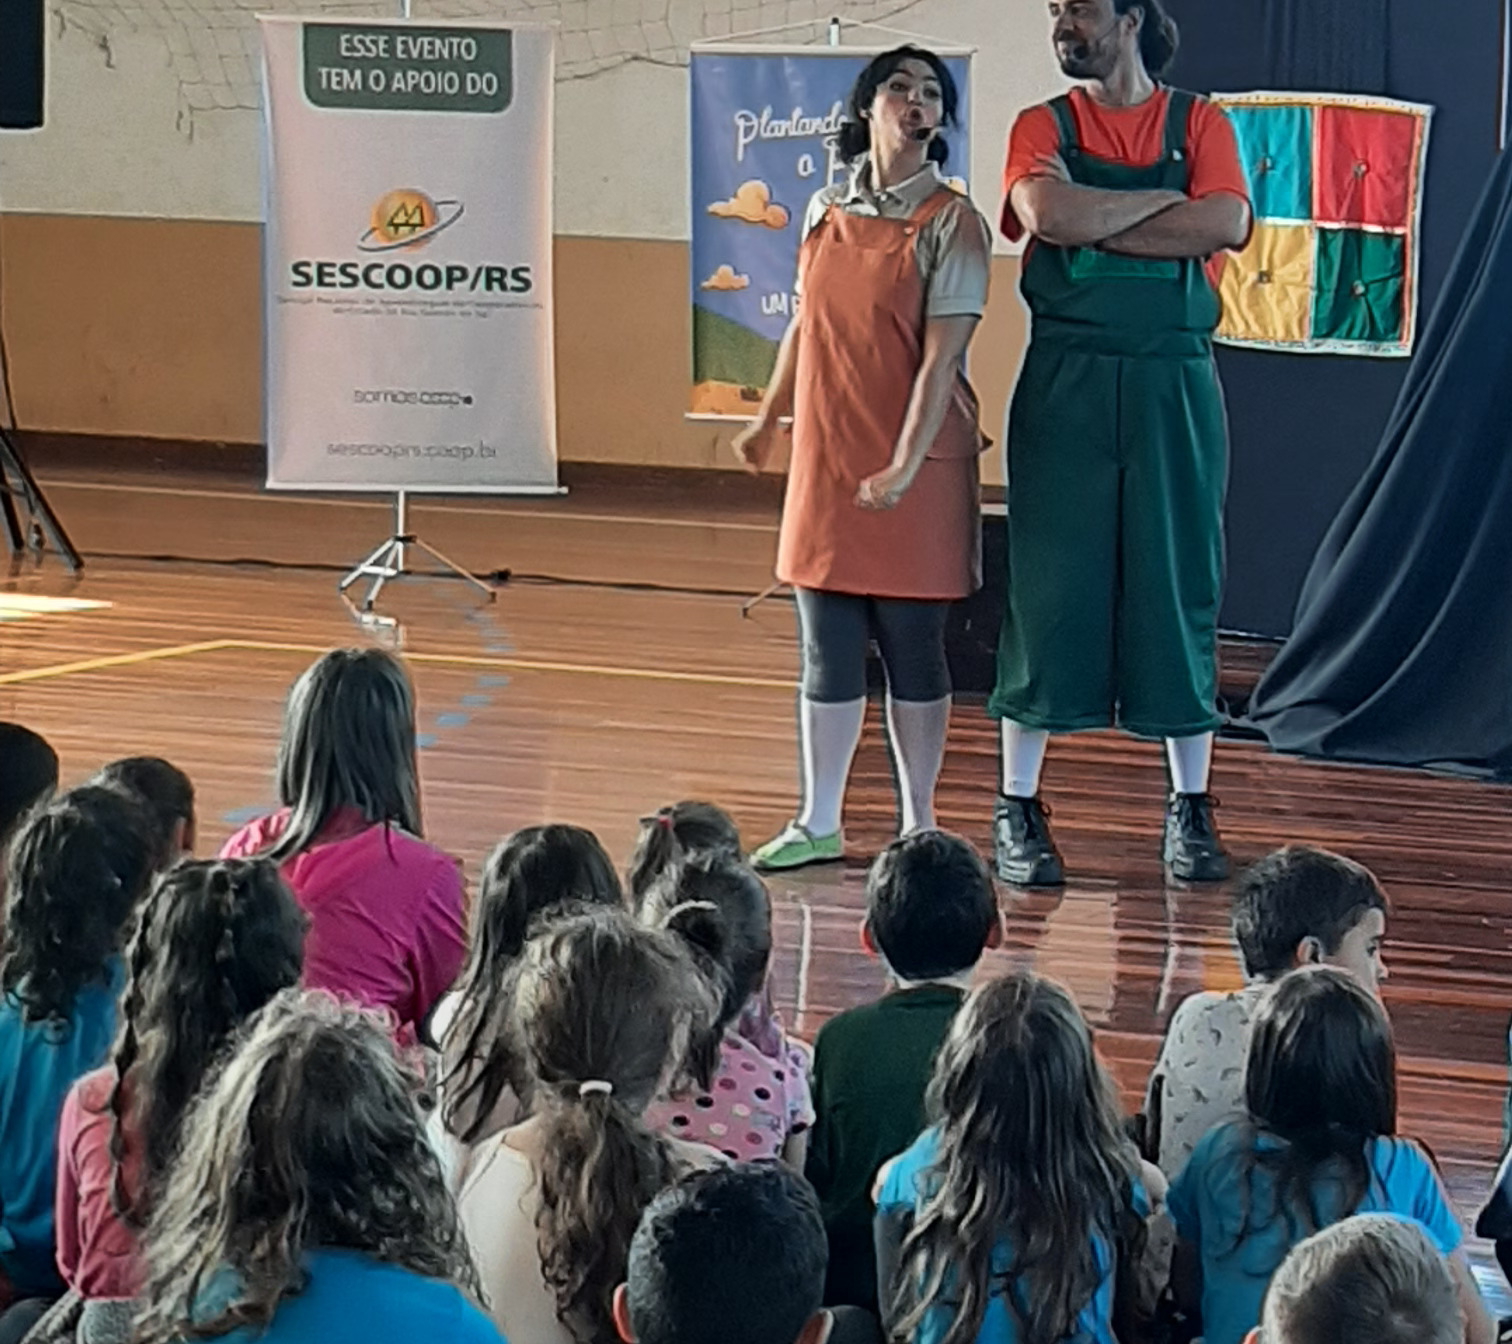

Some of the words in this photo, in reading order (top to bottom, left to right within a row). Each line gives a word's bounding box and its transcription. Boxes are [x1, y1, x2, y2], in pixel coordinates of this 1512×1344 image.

[339, 34, 390, 58] ESSE
[396, 35, 477, 61] EVENTO
[318, 66, 362, 92] TEM
[368, 68, 386, 93] O
[391, 70, 458, 94] APOIO
[466, 72, 498, 96] DO
[290, 259, 533, 293] SESCOOP/RS
